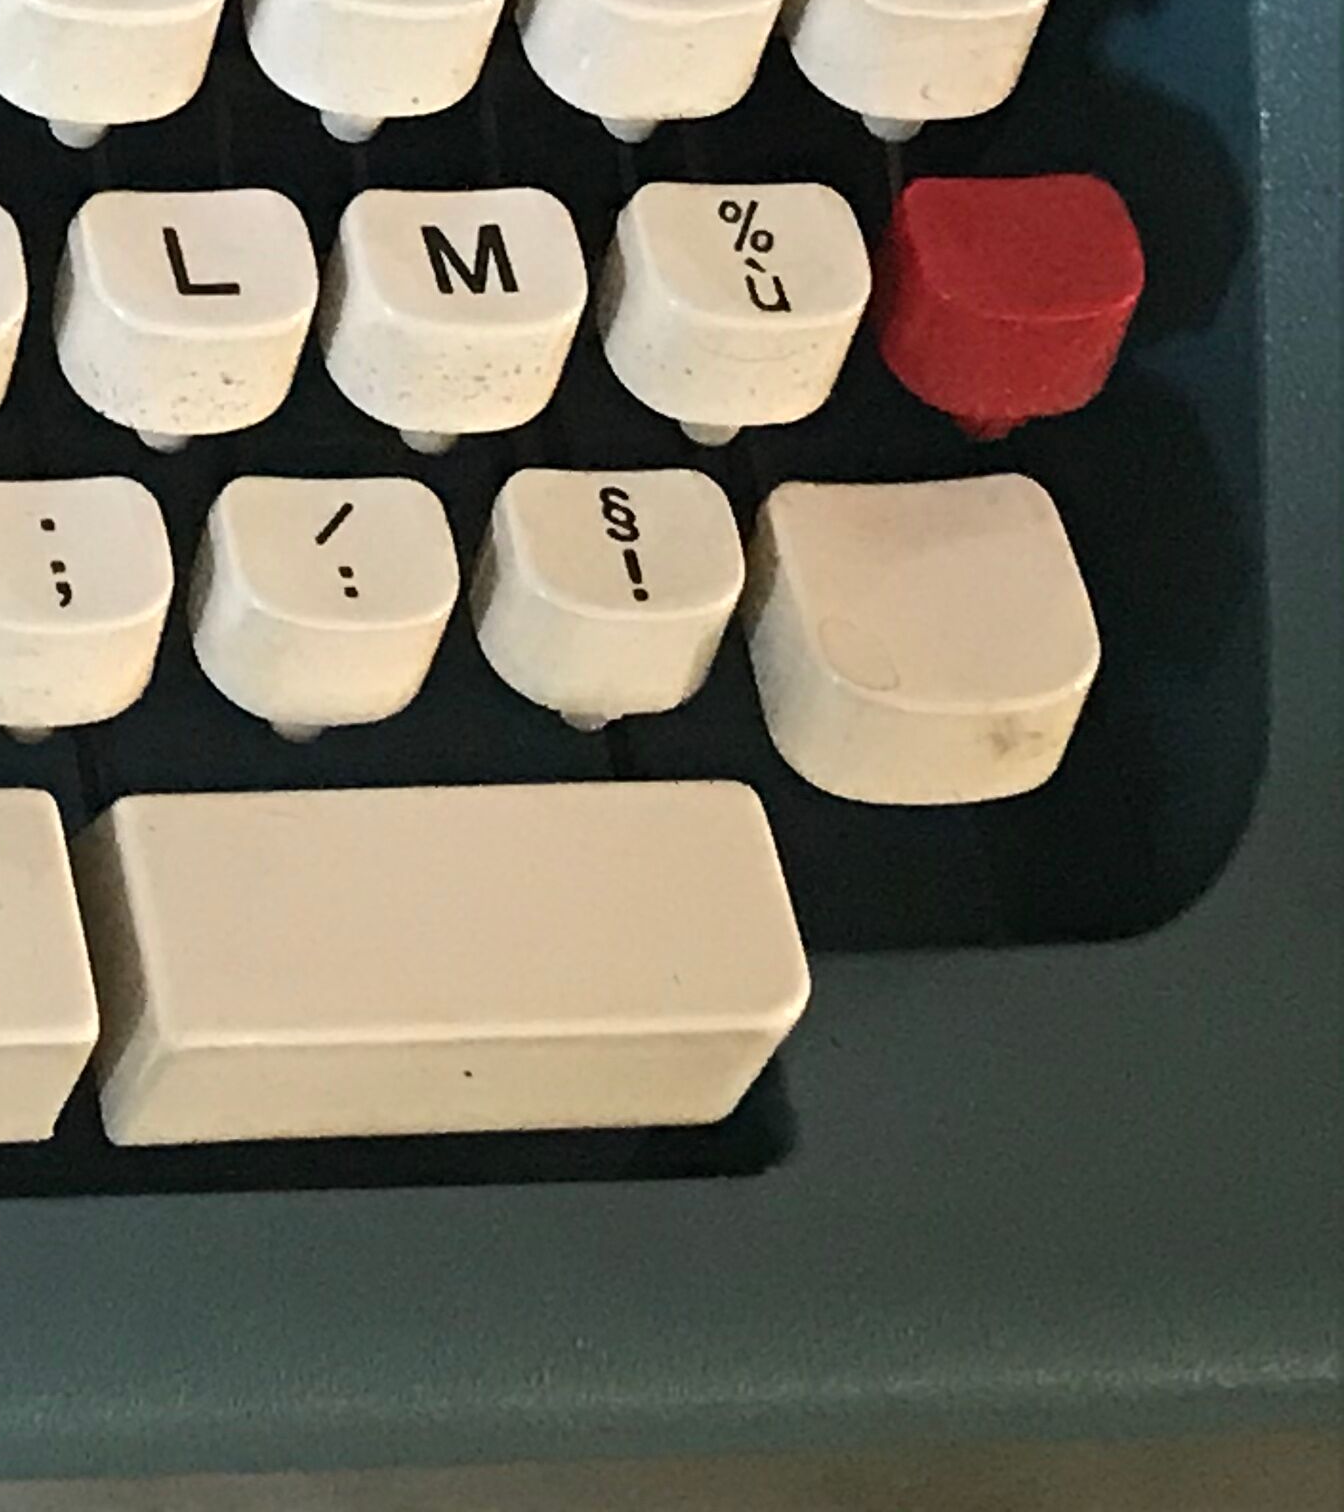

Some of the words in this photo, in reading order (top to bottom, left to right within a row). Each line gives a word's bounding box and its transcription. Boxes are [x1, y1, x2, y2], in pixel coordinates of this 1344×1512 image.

[717, 198, 775, 255] %
[161, 226, 242, 297] L
[419, 223, 520, 296] M
[743, 256, 793, 314] ù
[314, 501, 355, 547] /
[598, 485, 641, 544] §
[49, 559, 74, 609] ;
[621, 547, 650, 603] !
